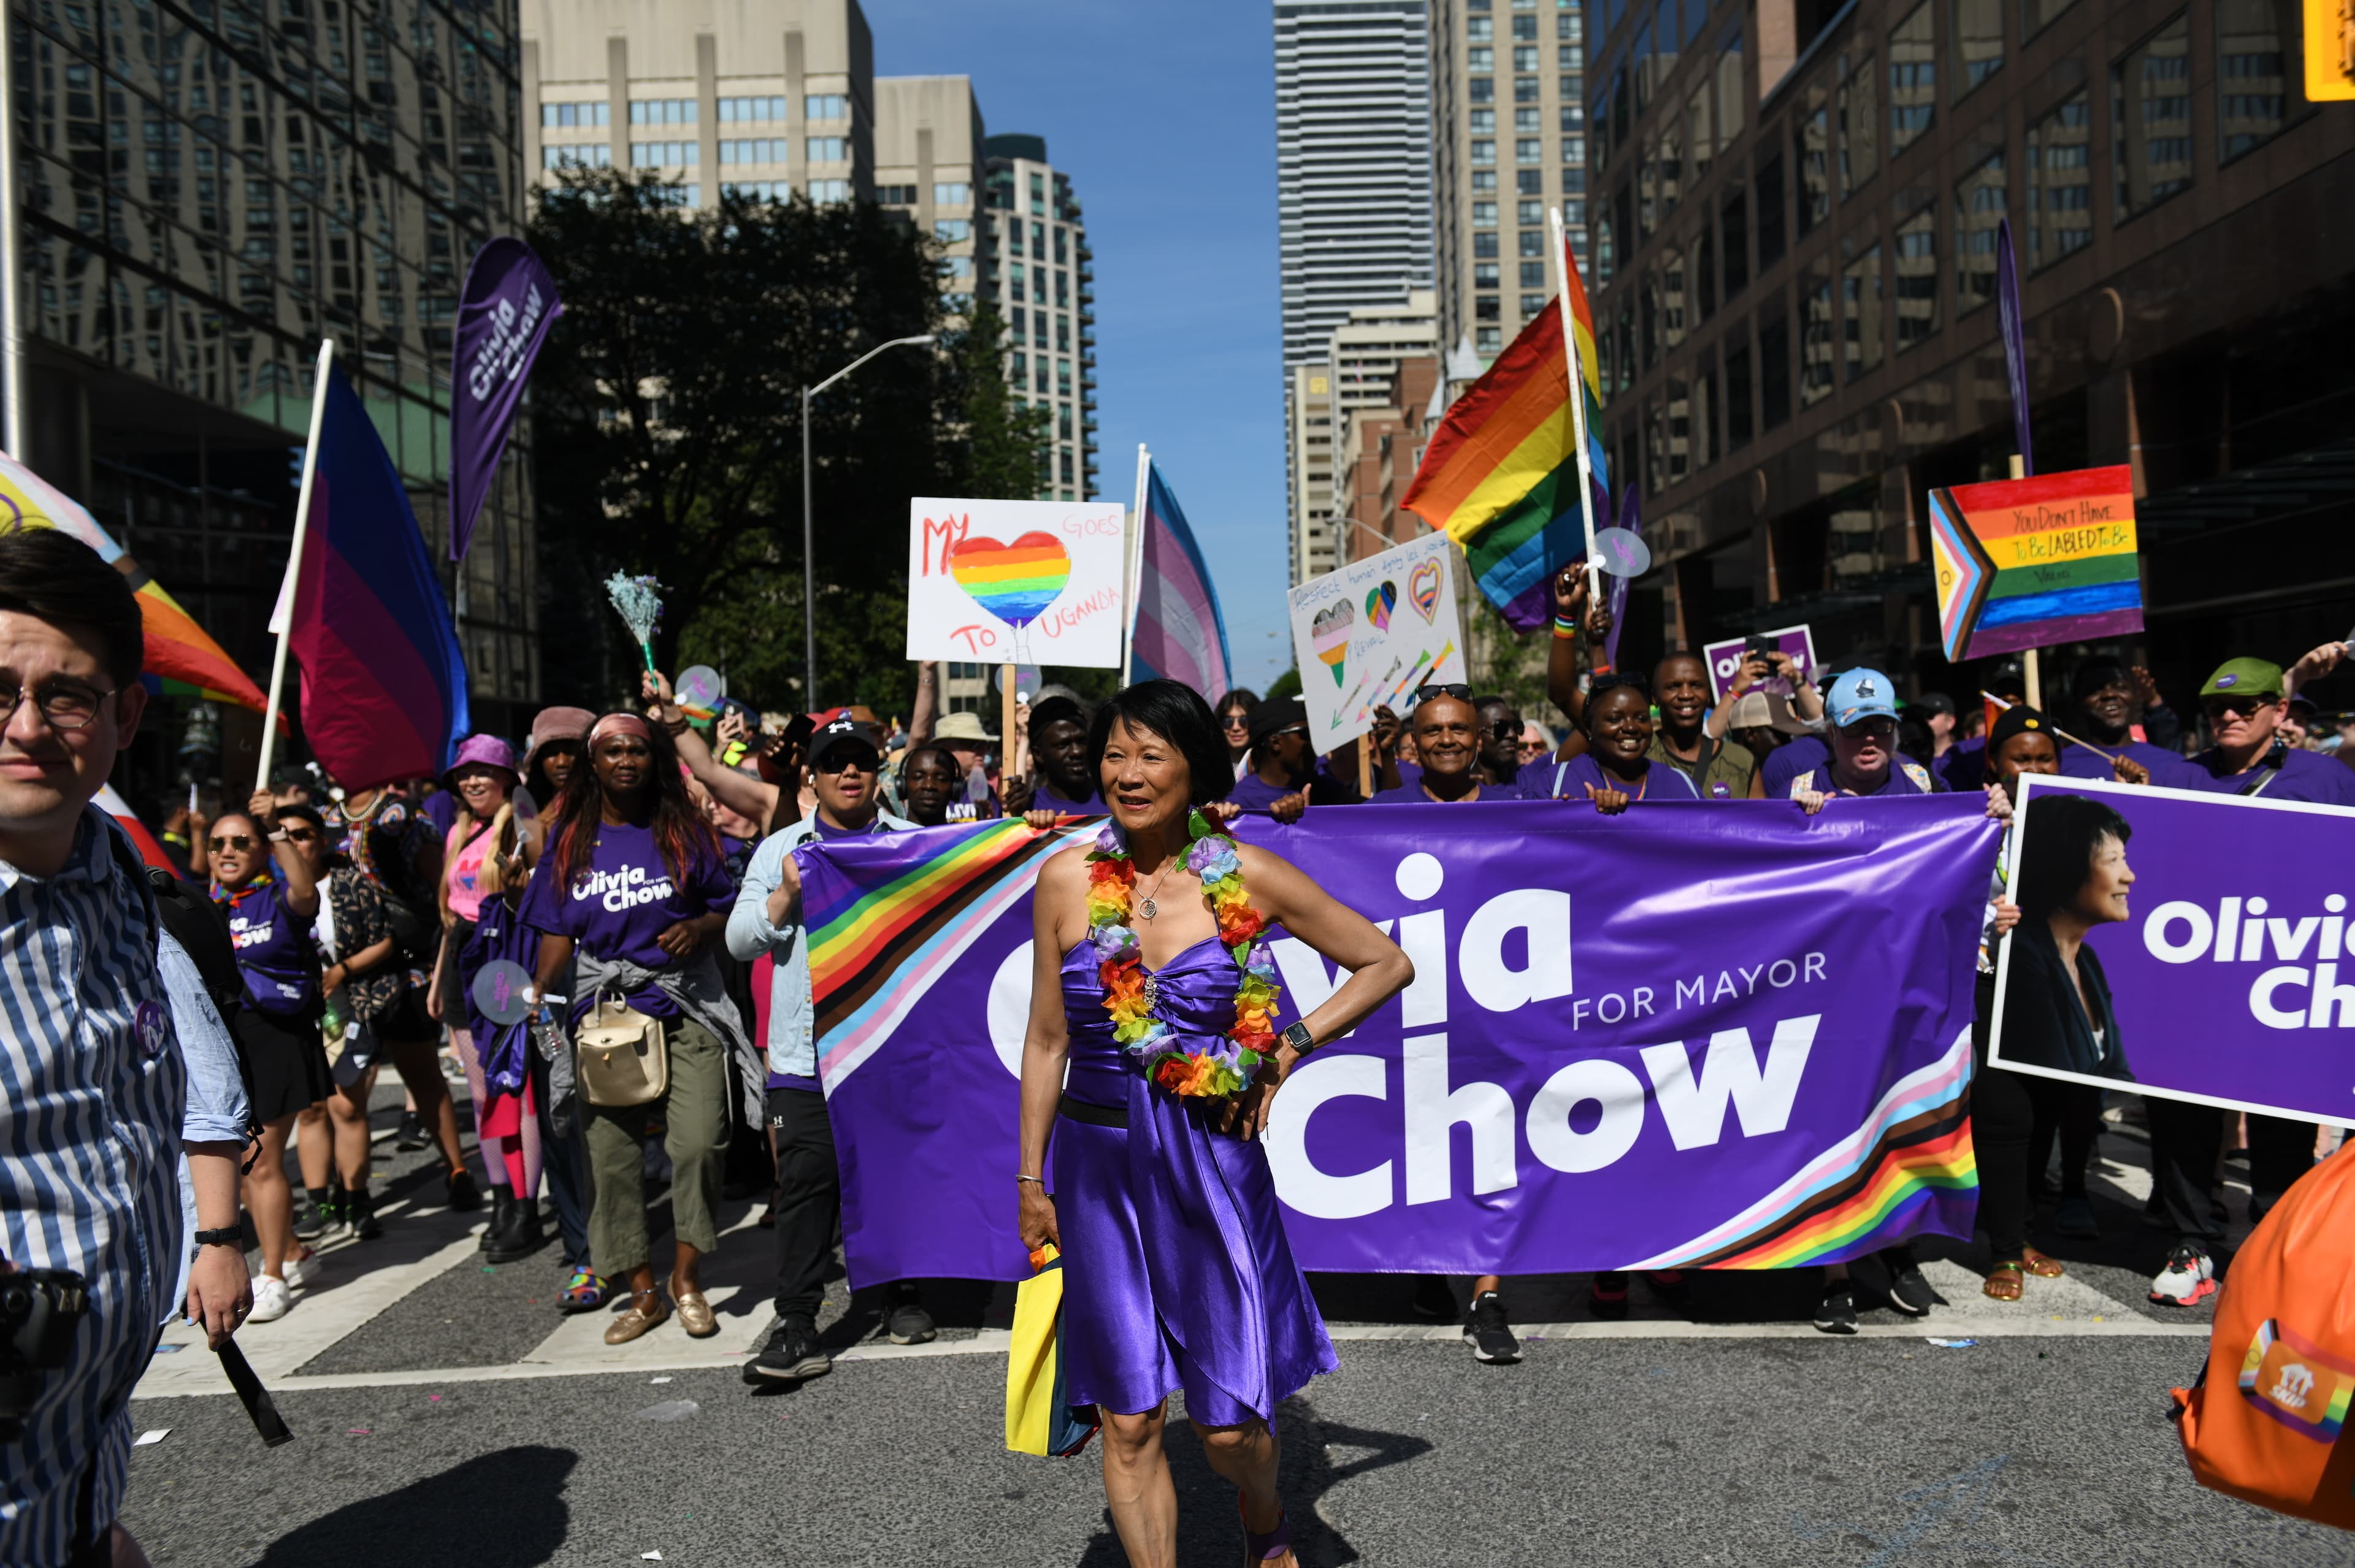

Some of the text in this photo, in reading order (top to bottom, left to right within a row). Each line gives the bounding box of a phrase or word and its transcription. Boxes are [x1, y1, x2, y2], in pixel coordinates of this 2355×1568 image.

[469, 297, 516, 402] Olivia
[922, 513, 1120, 578] MY GOES
[2048, 529, 2096, 557] LABLED
[2079, 502, 2114, 523] HAVE
[949, 586, 1120, 656] TO UGANDA
[602, 882, 673, 912] Chow
[2143, 893, 2355, 964] Olivi
[1573, 951, 1828, 1031] FOR MAYOR
[1260, 1012, 1821, 1220] Chow
[2269, 1385, 2306, 1407] SKIP
